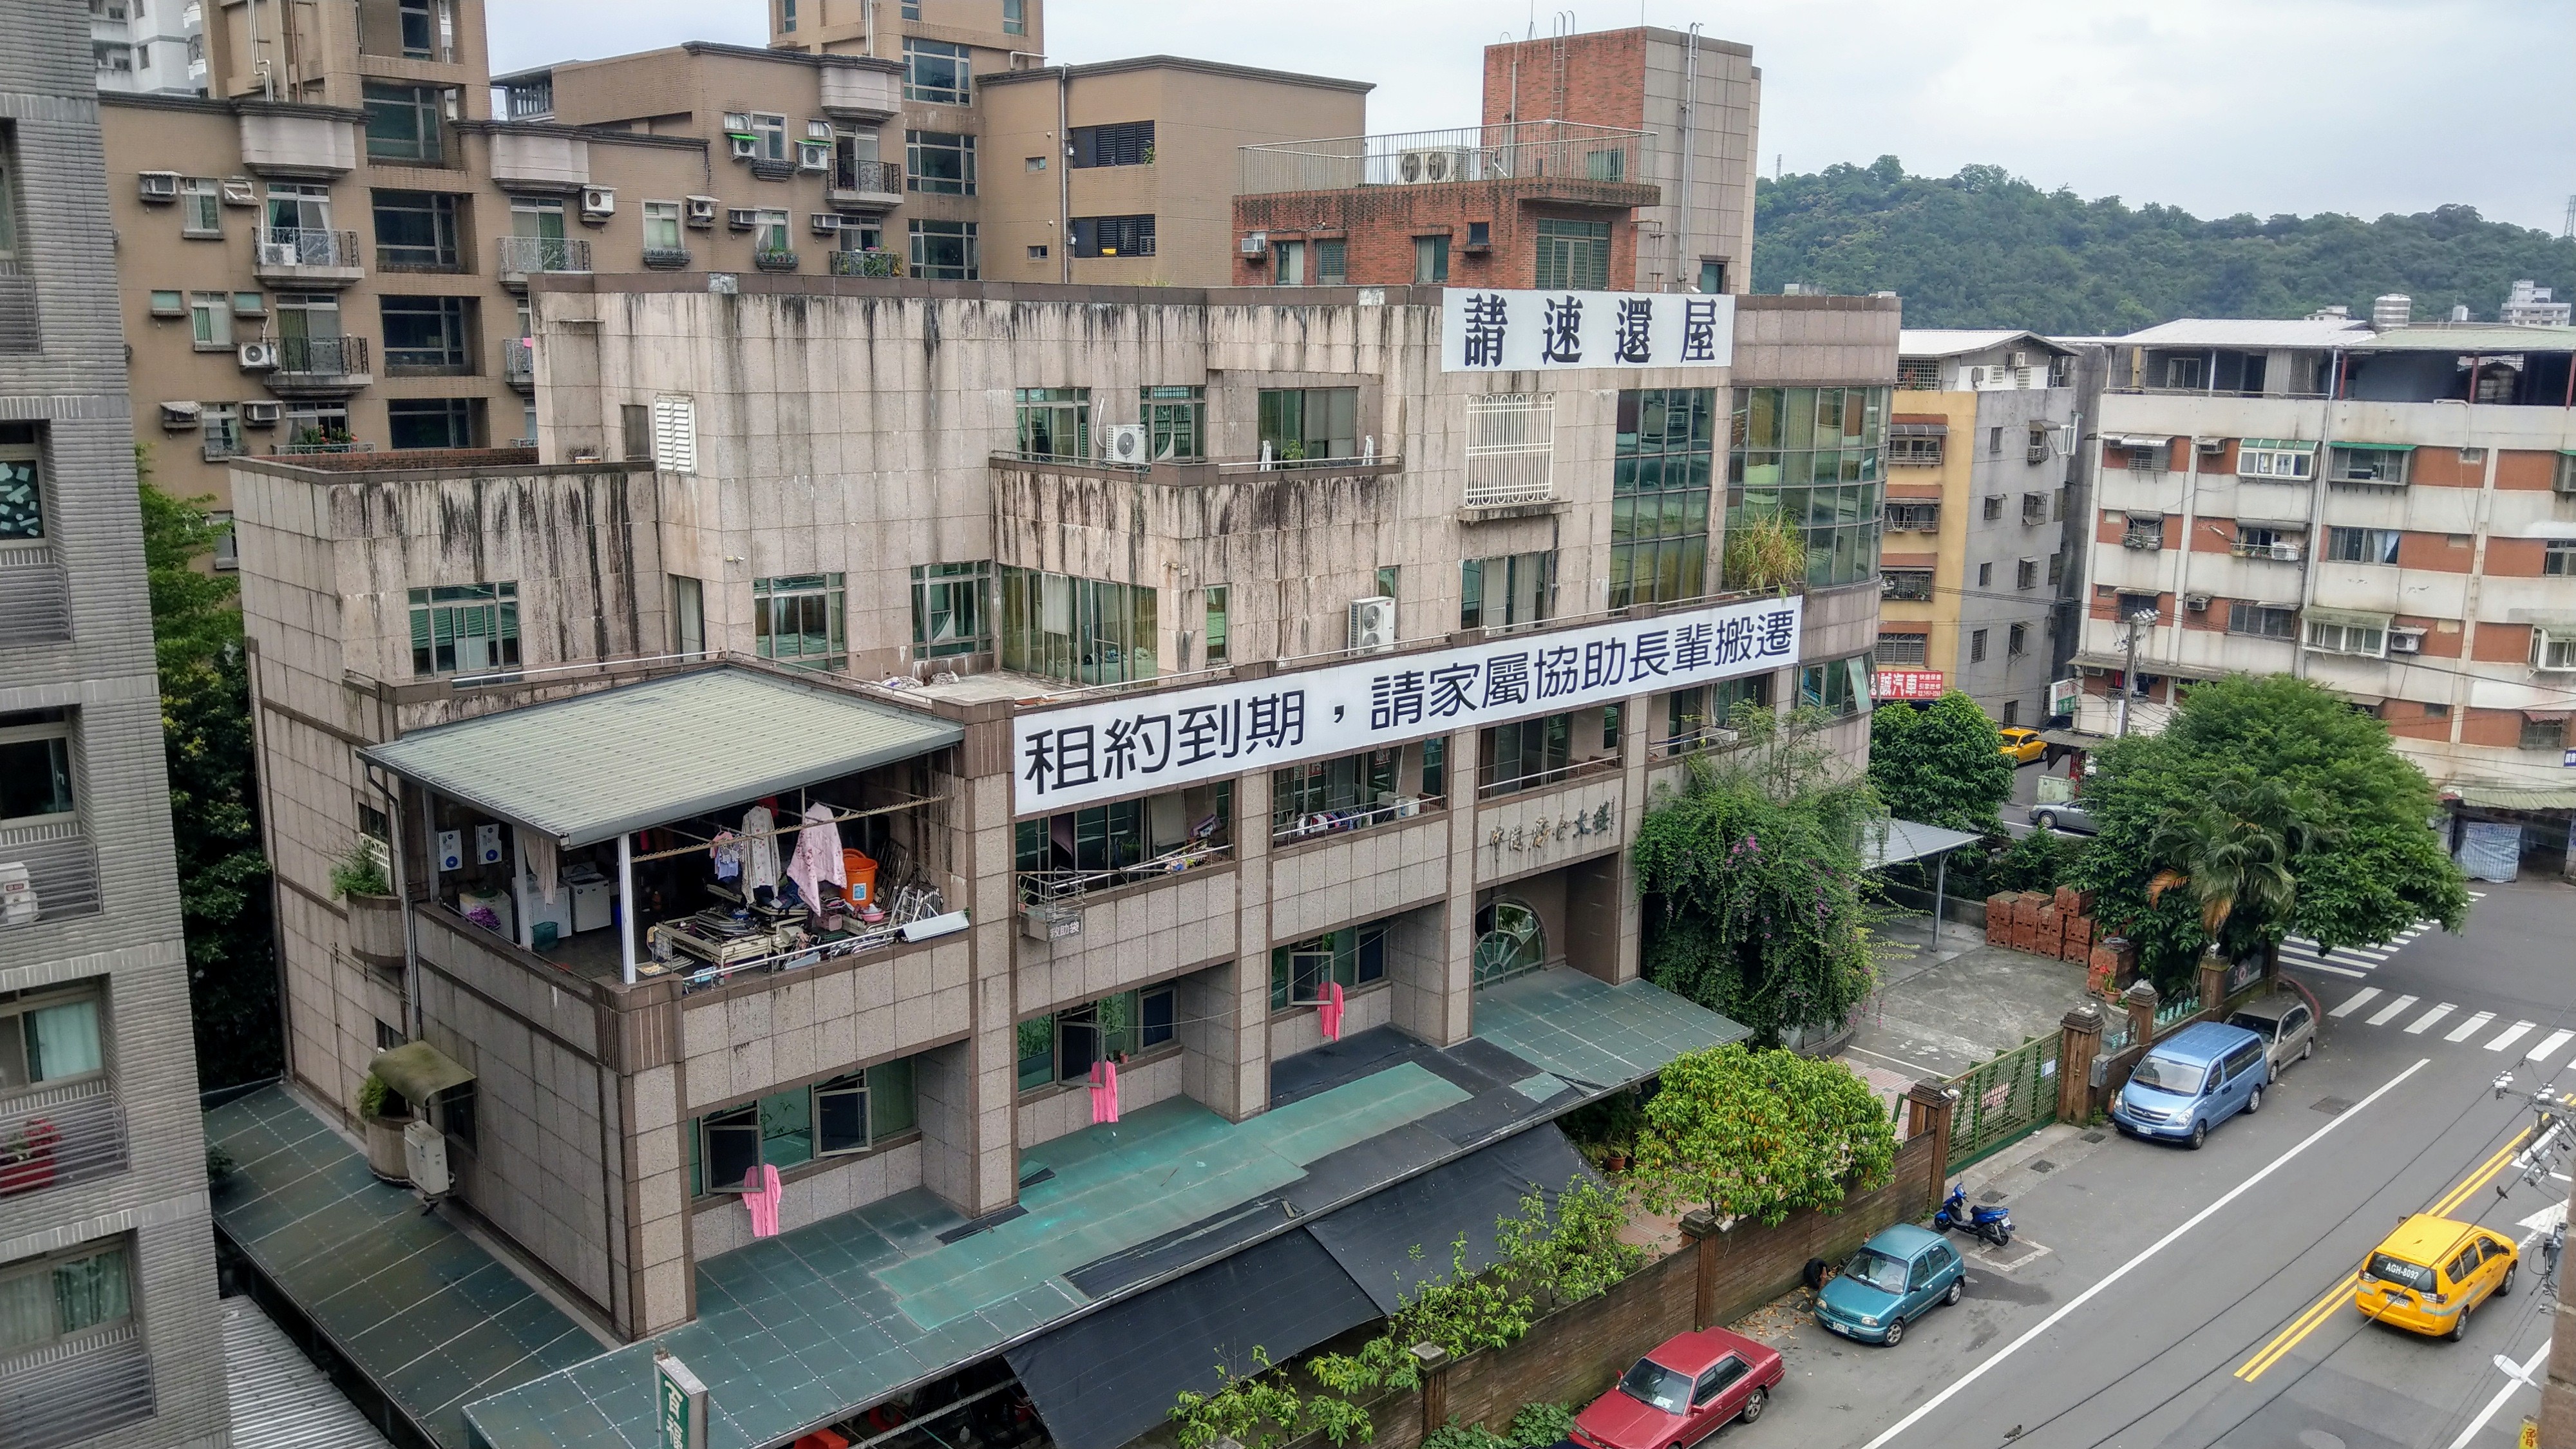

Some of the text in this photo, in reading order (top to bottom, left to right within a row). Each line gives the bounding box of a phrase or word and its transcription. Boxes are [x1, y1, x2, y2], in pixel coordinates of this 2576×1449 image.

[1464, 293, 1718, 368] 請速還屋
[1024, 609, 1794, 795] 租約到期，請家屬協助長輩搬遷
[1050, 921, 1079, 938] 救助袋
